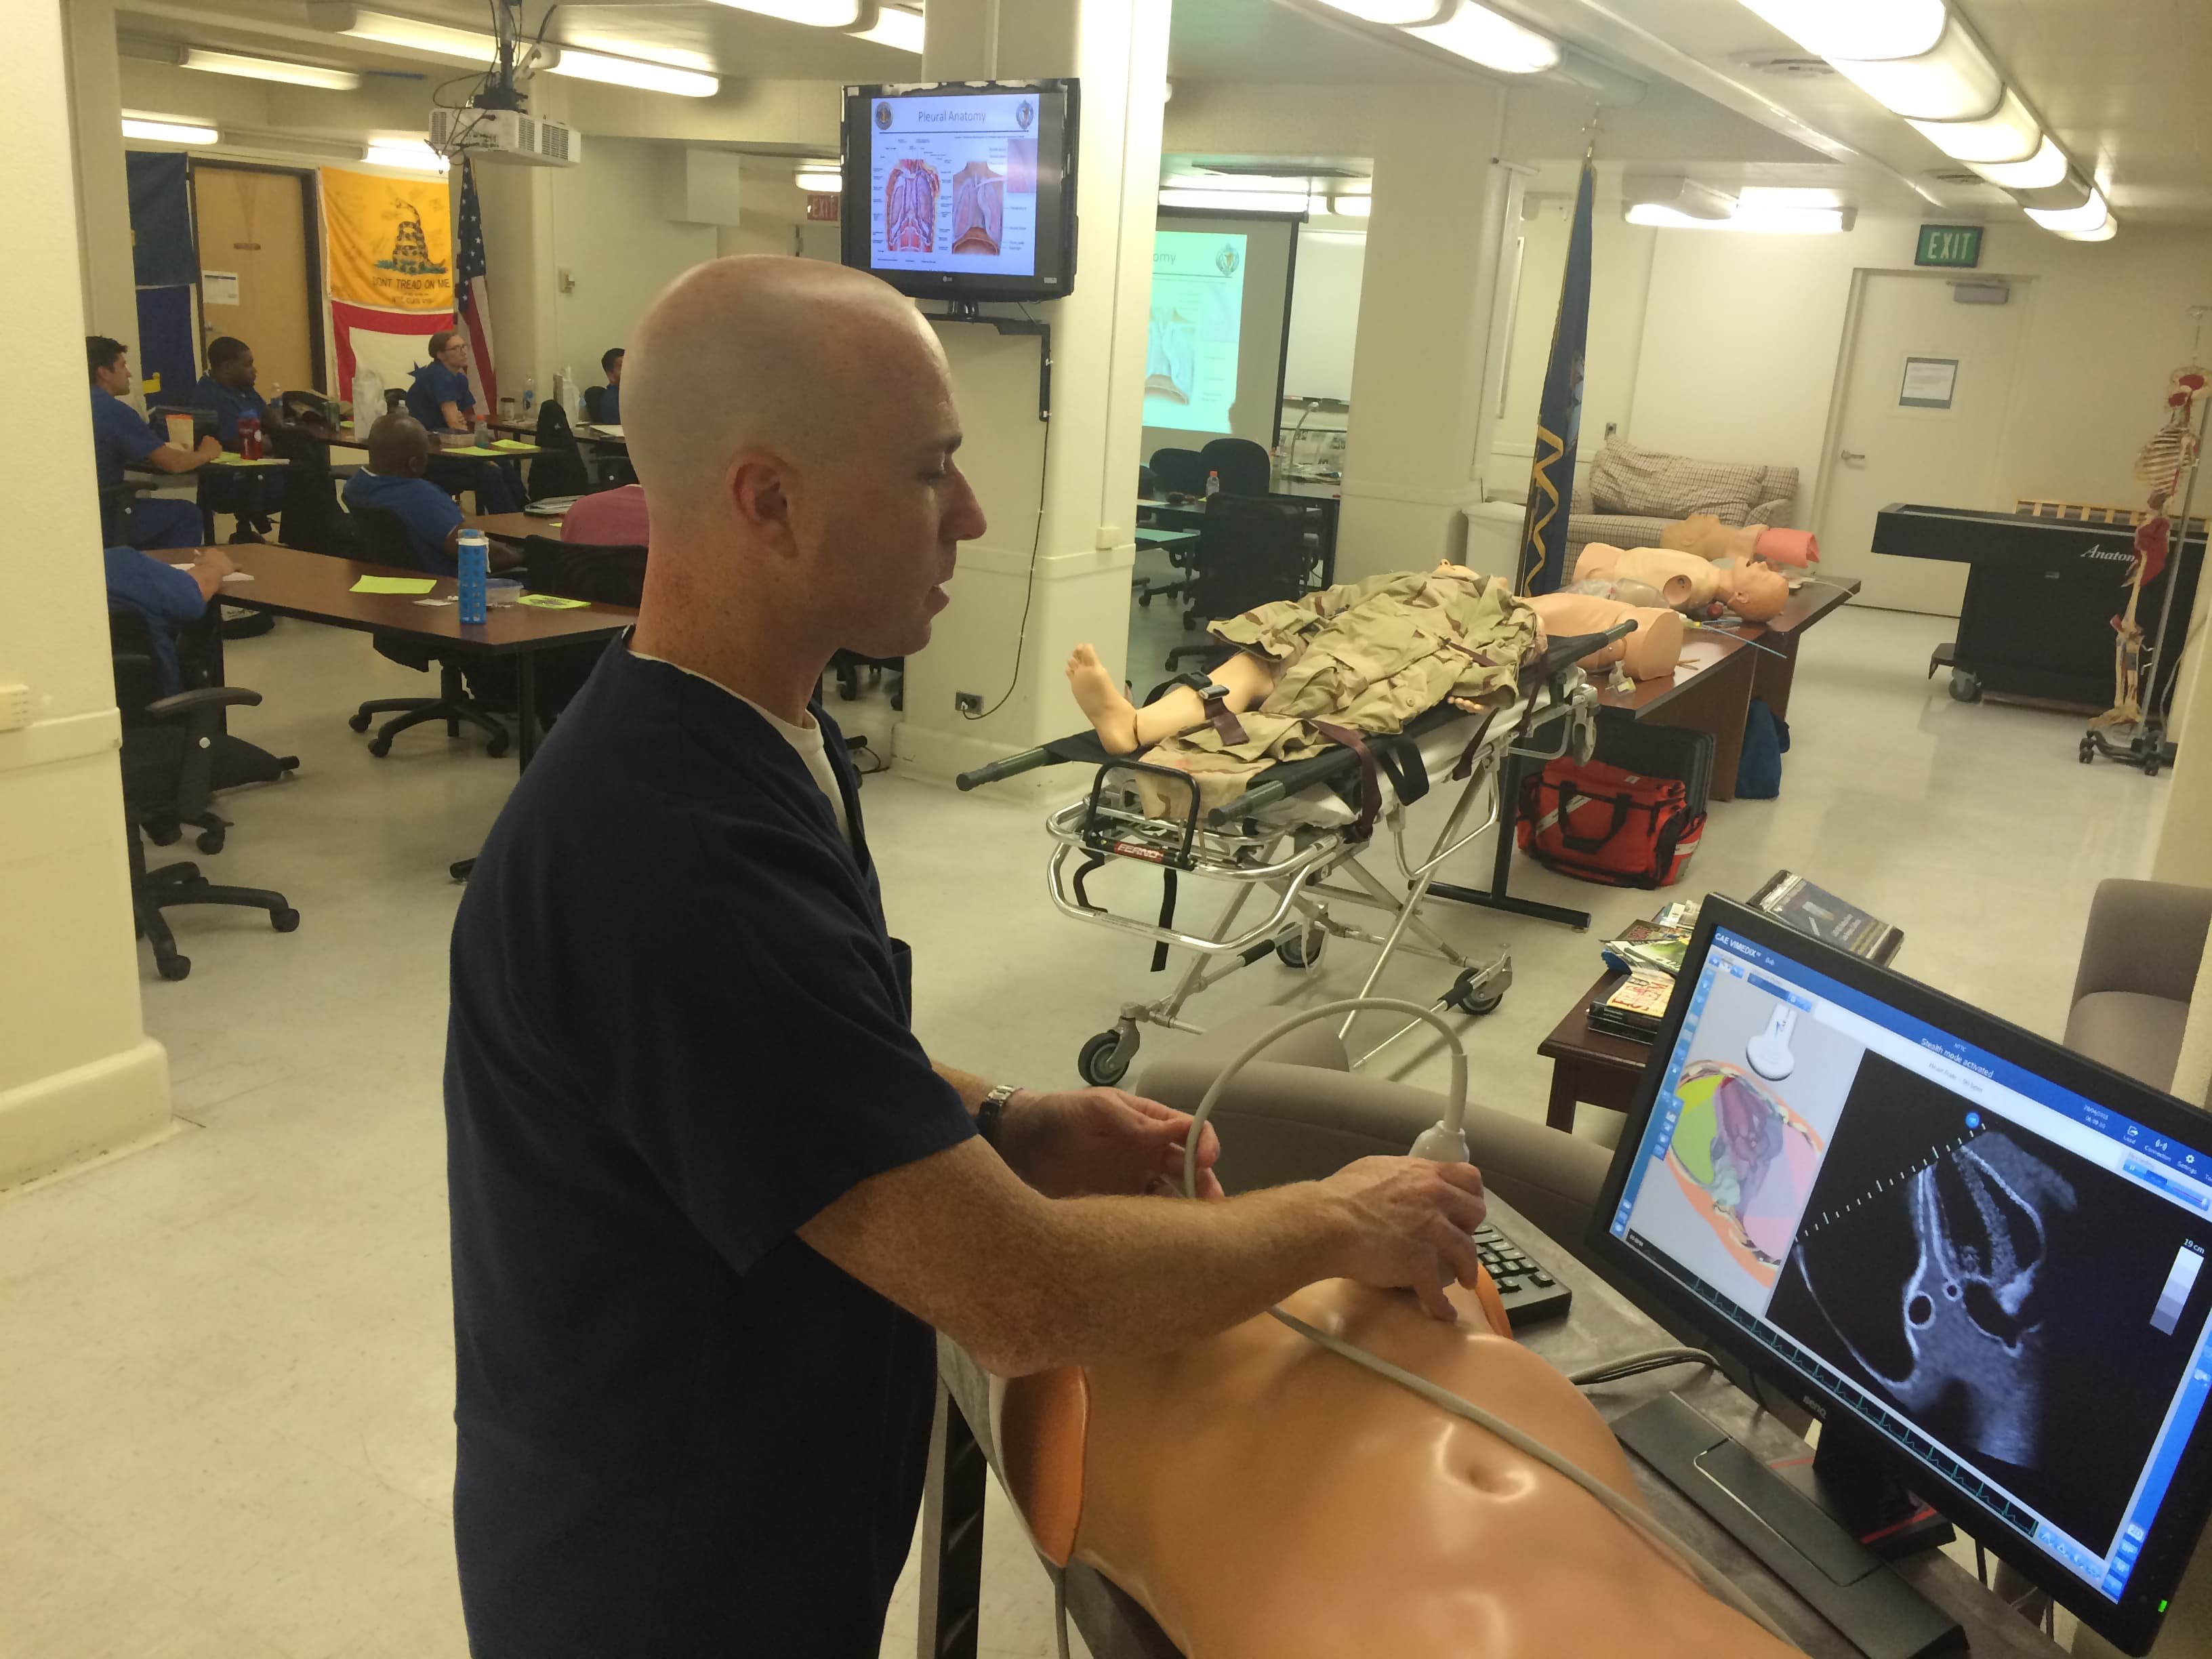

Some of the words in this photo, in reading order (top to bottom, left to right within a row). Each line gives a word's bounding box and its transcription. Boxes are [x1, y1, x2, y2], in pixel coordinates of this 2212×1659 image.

[918, 110, 946, 122] Pleural
[949, 111, 986, 123] Anatomy
[813, 198, 835, 218] EXIT
[1927, 232, 1971, 260] EXIT
[1153, 253, 1176, 265] omy
[396, 279, 422, 289] TREAD
[424, 279, 434, 289] ON
[438, 279, 450, 287] ME
[1118, 843, 1160, 859] FERNO
[1715, 933, 1730, 945] CAE
[1730, 939, 1757, 957] VIMEDIX
[1921, 1038, 1944, 1054] Stealth
[1944, 1050, 1963, 1063] mode
[1963, 1059, 1994, 1078] activated
[2144, 1145, 2172, 1162] Connection
[2177, 1161, 2197, 1174] Settings
[2184, 1238, 2194, 1248] 19
[2193, 1244, 2205, 1254] cm
[1803, 1395, 1827, 1419] BenQ
